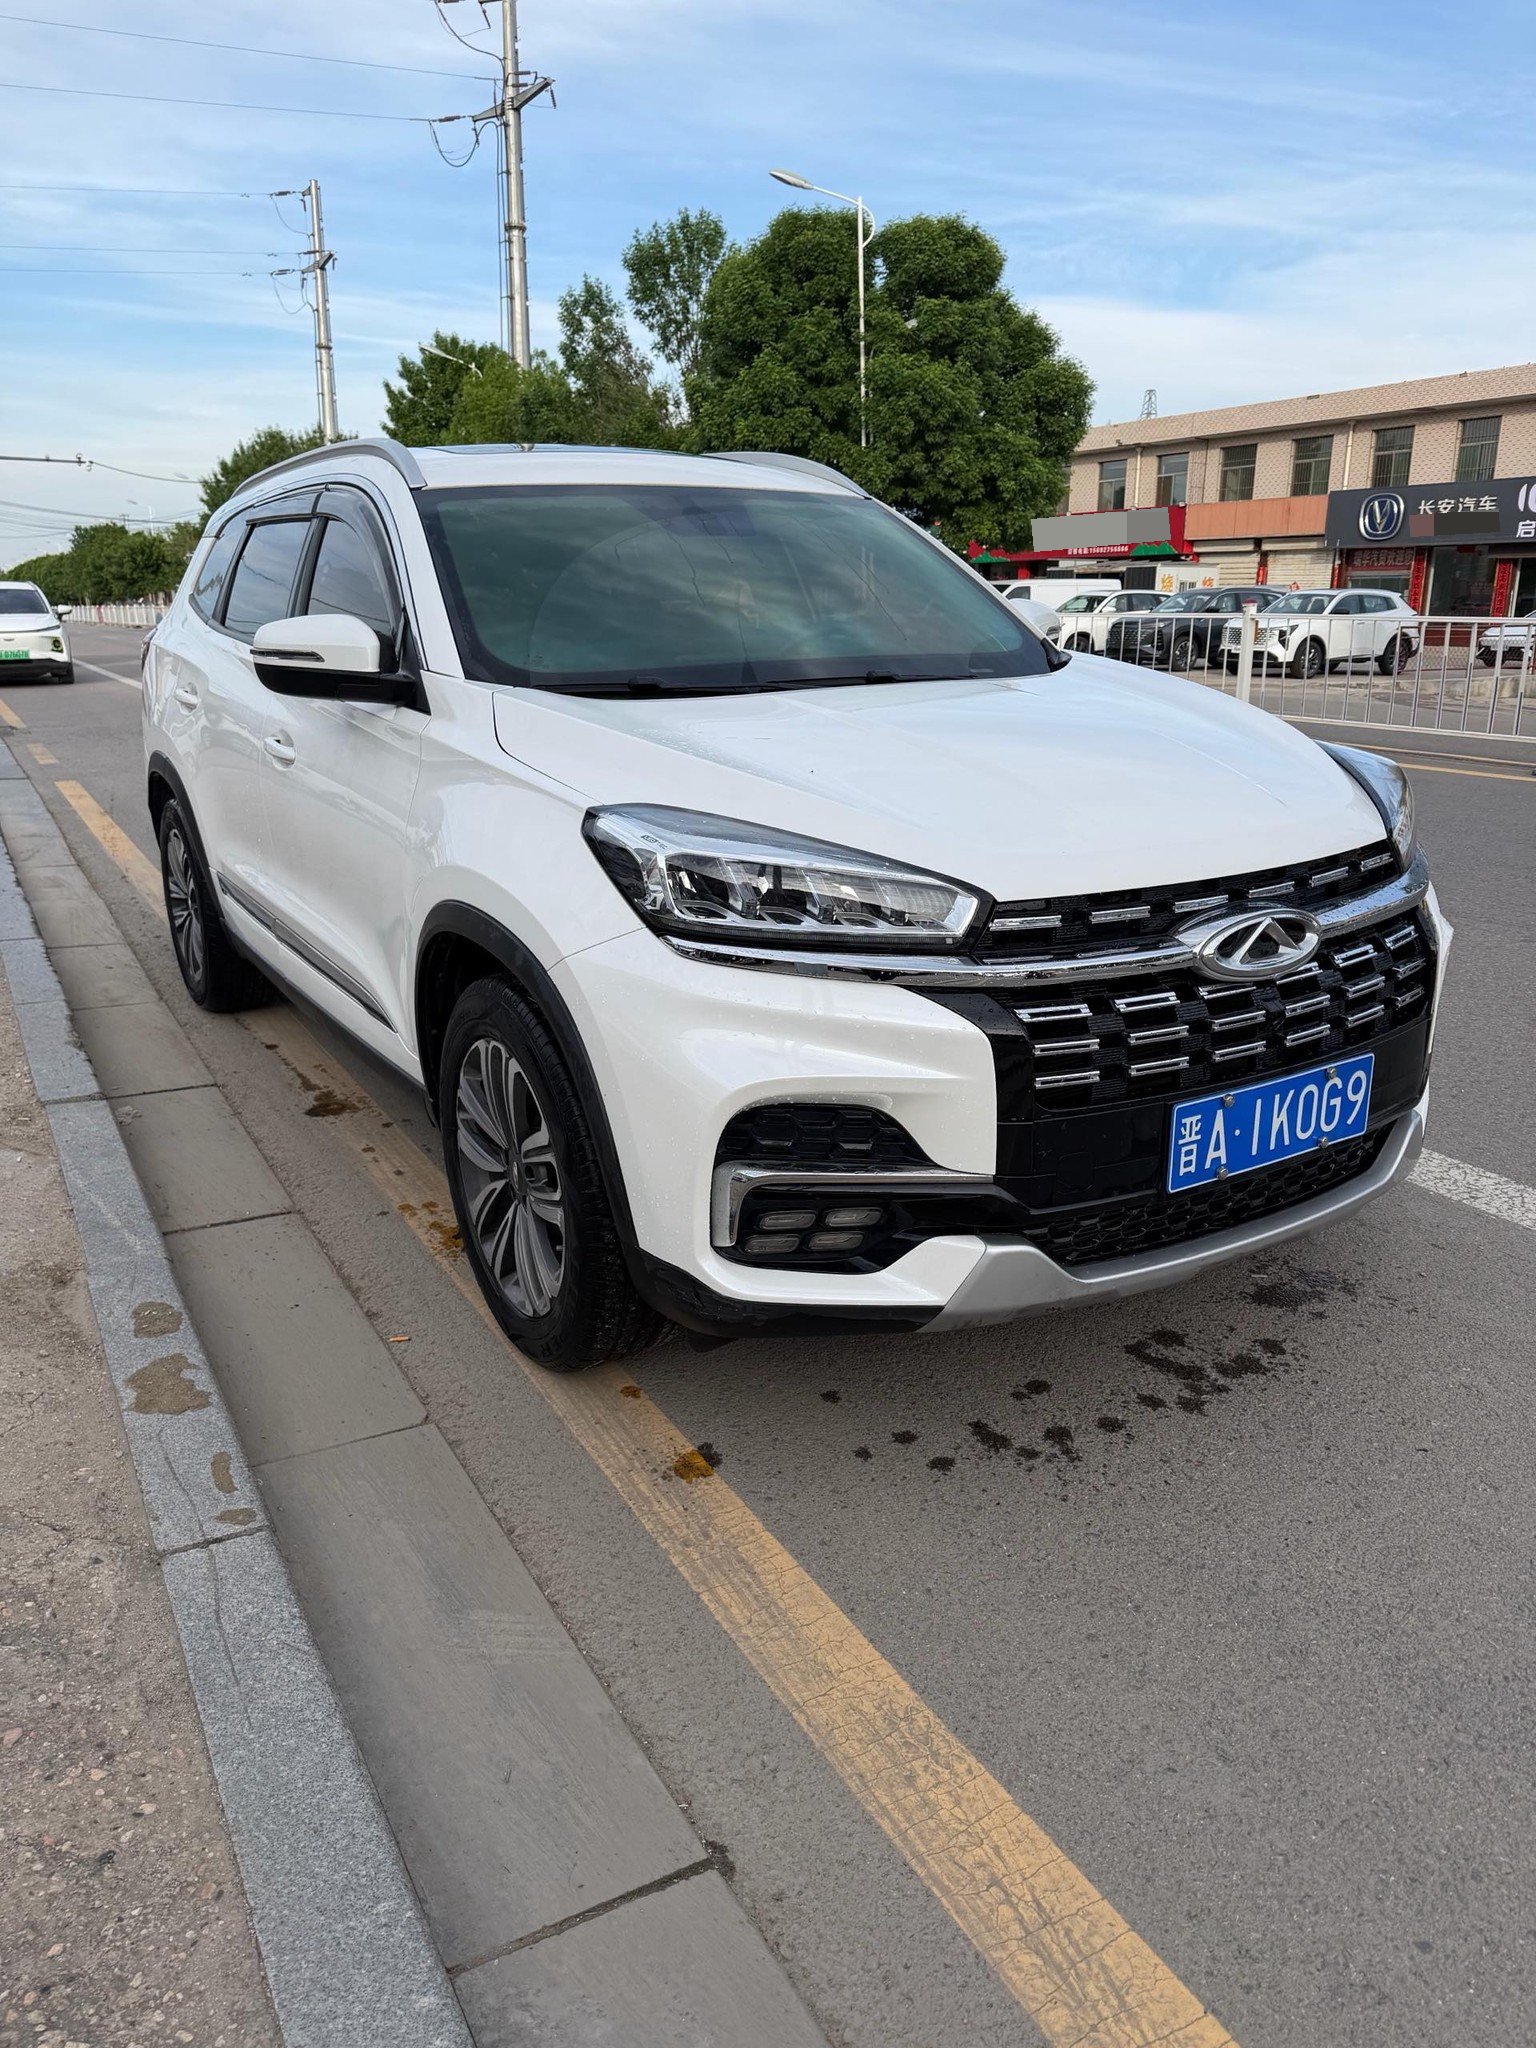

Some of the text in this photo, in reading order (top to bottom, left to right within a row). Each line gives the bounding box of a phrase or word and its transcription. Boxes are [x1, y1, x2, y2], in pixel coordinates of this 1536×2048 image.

[1418, 495, 1498, 514] 长安汽车
[1178, 1069, 1367, 1177] 晋A·1K0G9
